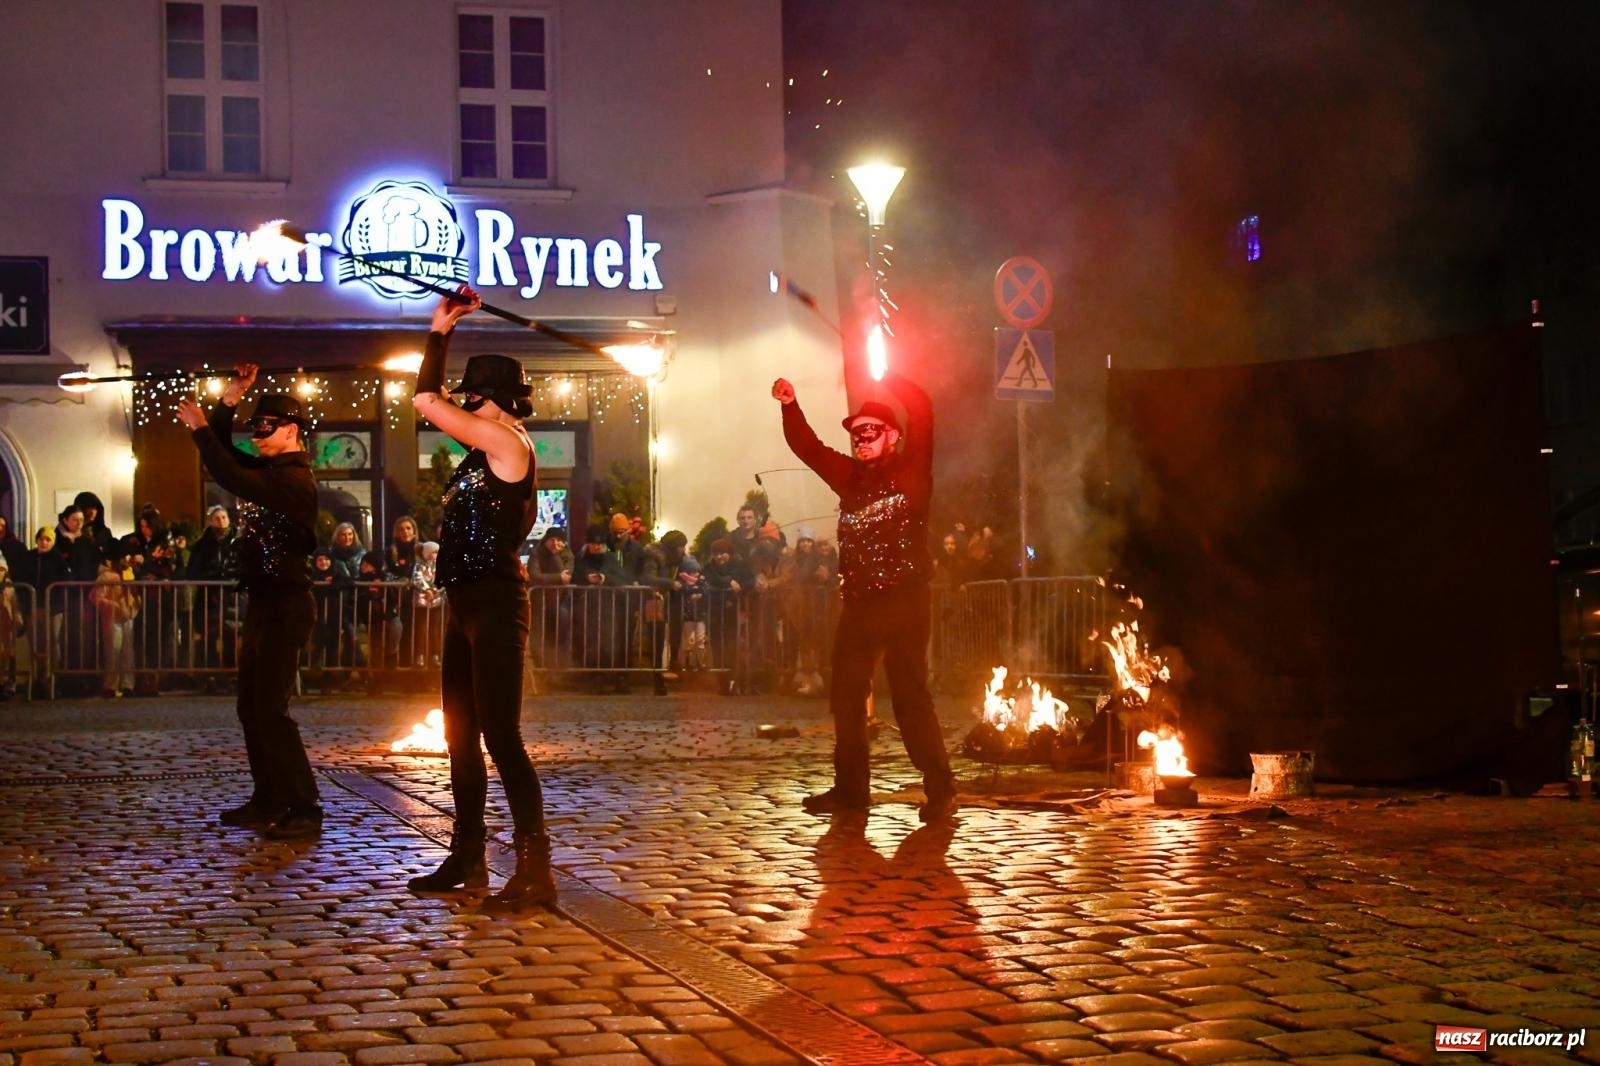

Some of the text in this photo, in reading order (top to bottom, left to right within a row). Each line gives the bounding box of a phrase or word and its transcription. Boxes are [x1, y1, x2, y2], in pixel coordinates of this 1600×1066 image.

[102, 198, 664, 299] Browar Rynek
[410, 253, 456, 279] Rynek
